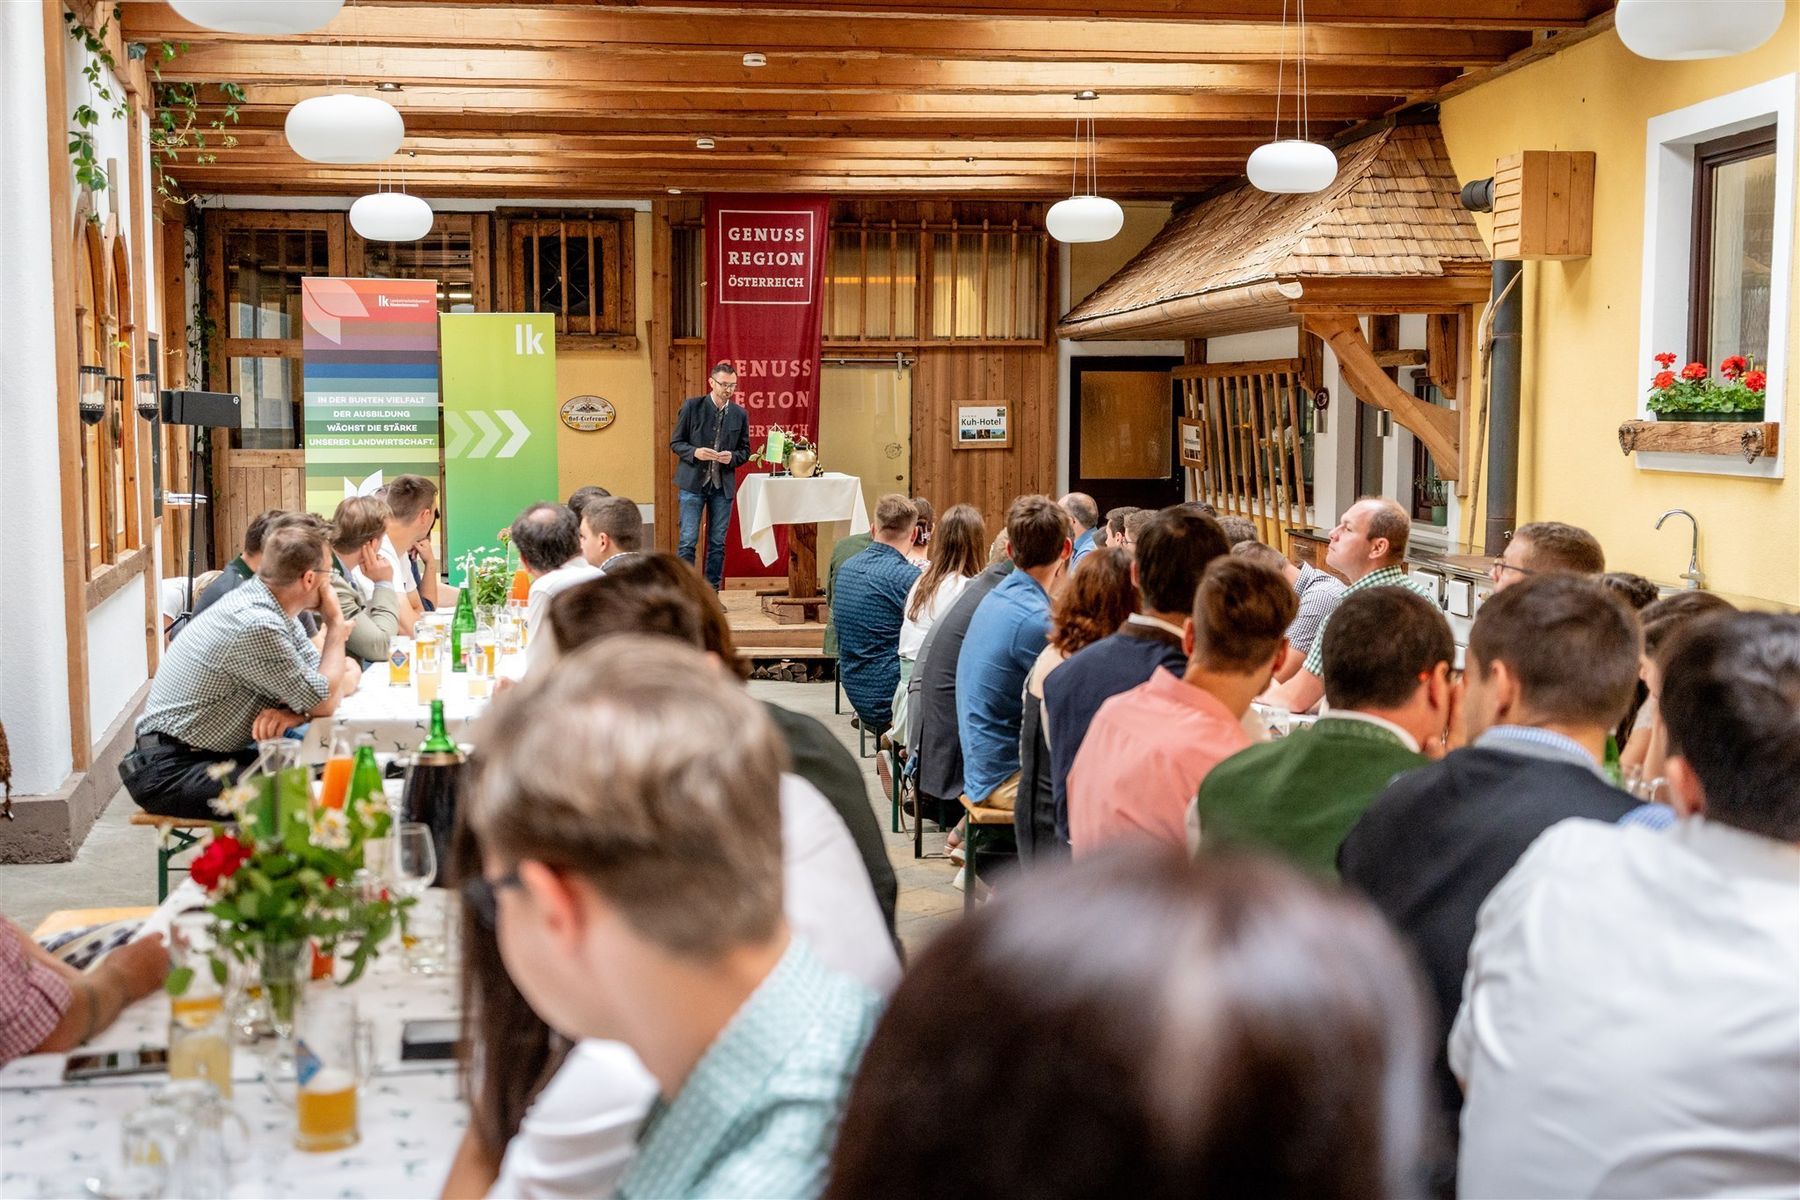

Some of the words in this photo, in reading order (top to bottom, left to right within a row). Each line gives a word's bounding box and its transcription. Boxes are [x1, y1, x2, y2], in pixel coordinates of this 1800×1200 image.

[728, 227, 805, 242] GENUSS
[728, 251, 804, 266] REGION
[728, 274, 804, 288] ÖSTERREICH
[378, 294, 389, 307] lk
[515, 323, 545, 355] lk
[718, 359, 811, 378] ENUSS
[317, 396, 327, 404] IN
[329, 396, 348, 404] DER
[349, 396, 384, 404] BUNTEN
[385, 396, 425, 404] VIELFALT
[734, 391, 810, 409] EGION
[333, 410, 352, 418] DER
[353, 410, 411, 418] AUSBILDUNG
[326, 422, 366, 432] WÄCHST
[367, 424, 382, 432] DIE
[383, 422, 418, 432] STÄRKE
[961, 418, 1001, 426] Kuh-Hotel
[309, 438, 351, 446] UNSERER
[352, 438, 435, 446] LANDWIRTSCHAFT.
